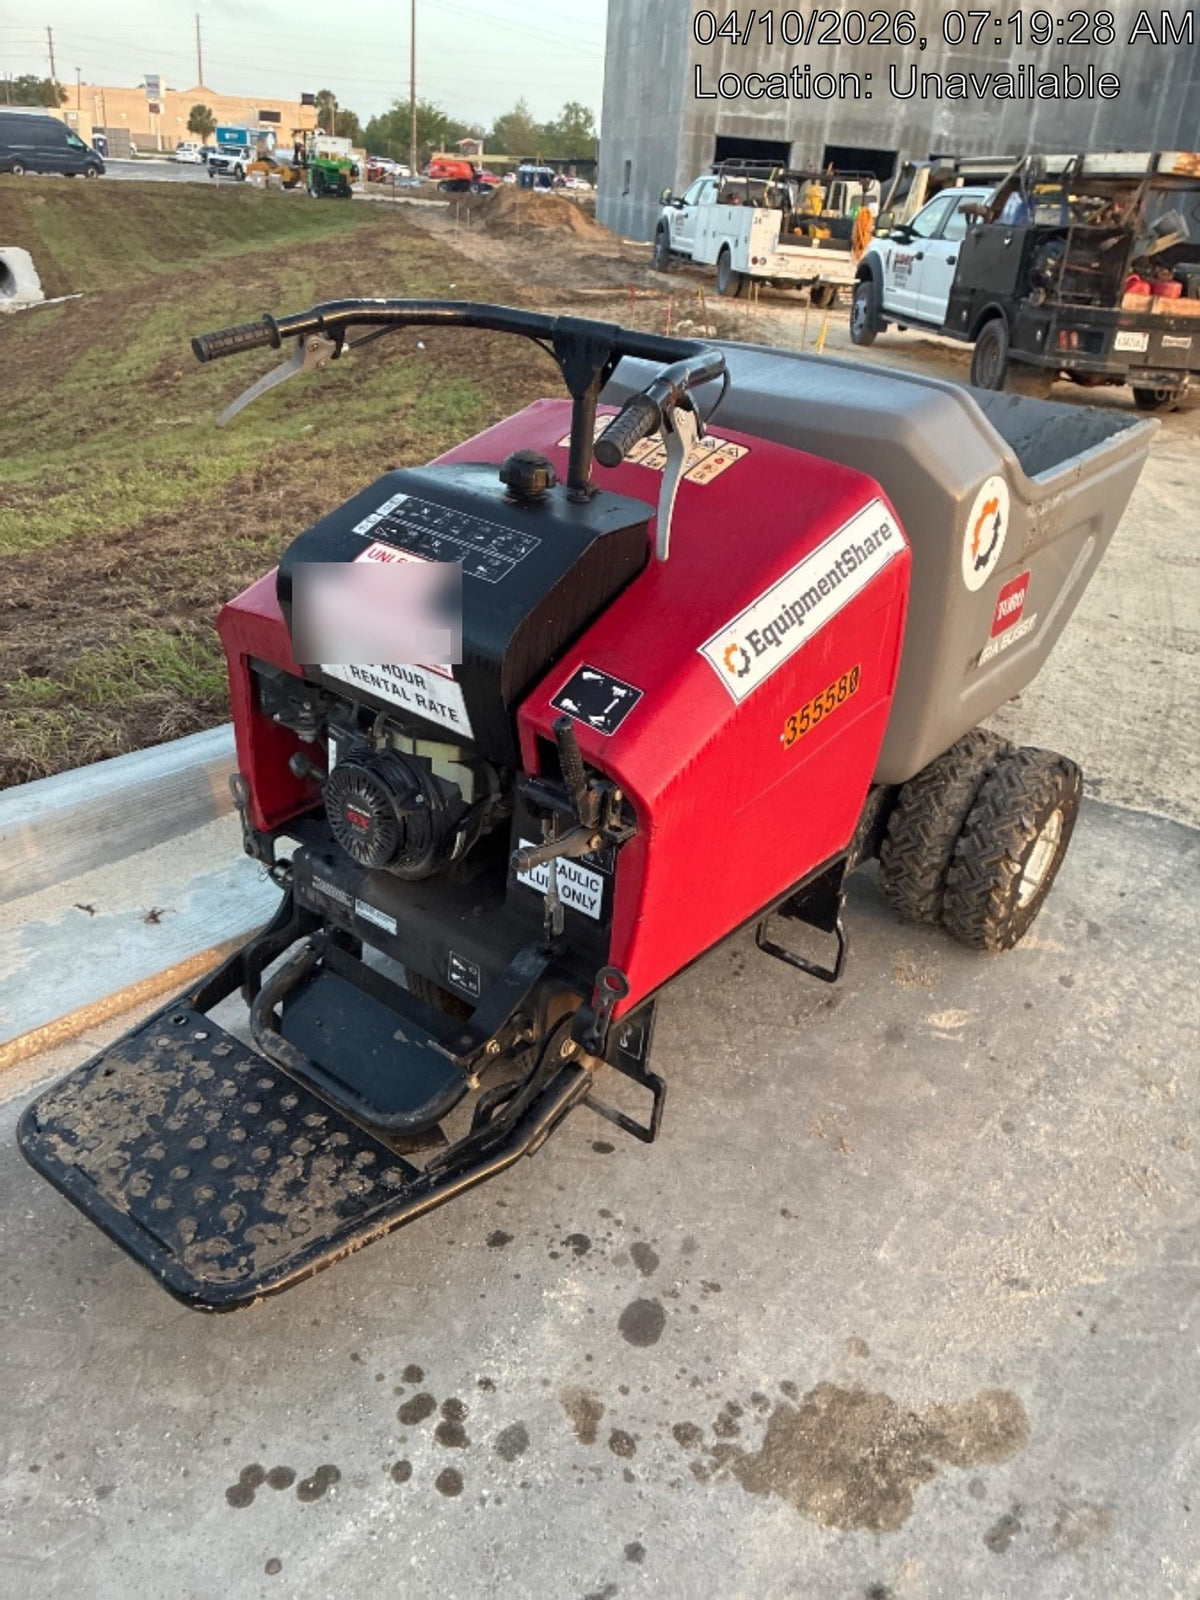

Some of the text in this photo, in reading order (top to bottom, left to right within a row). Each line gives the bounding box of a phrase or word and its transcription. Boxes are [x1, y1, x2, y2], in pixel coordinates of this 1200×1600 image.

[745, 521, 893, 658] EquipmentShare
[350, 664, 459, 723] RENTAL RATE
[785, 665, 860, 745] 355580
[561, 884, 597, 911] ONLY
